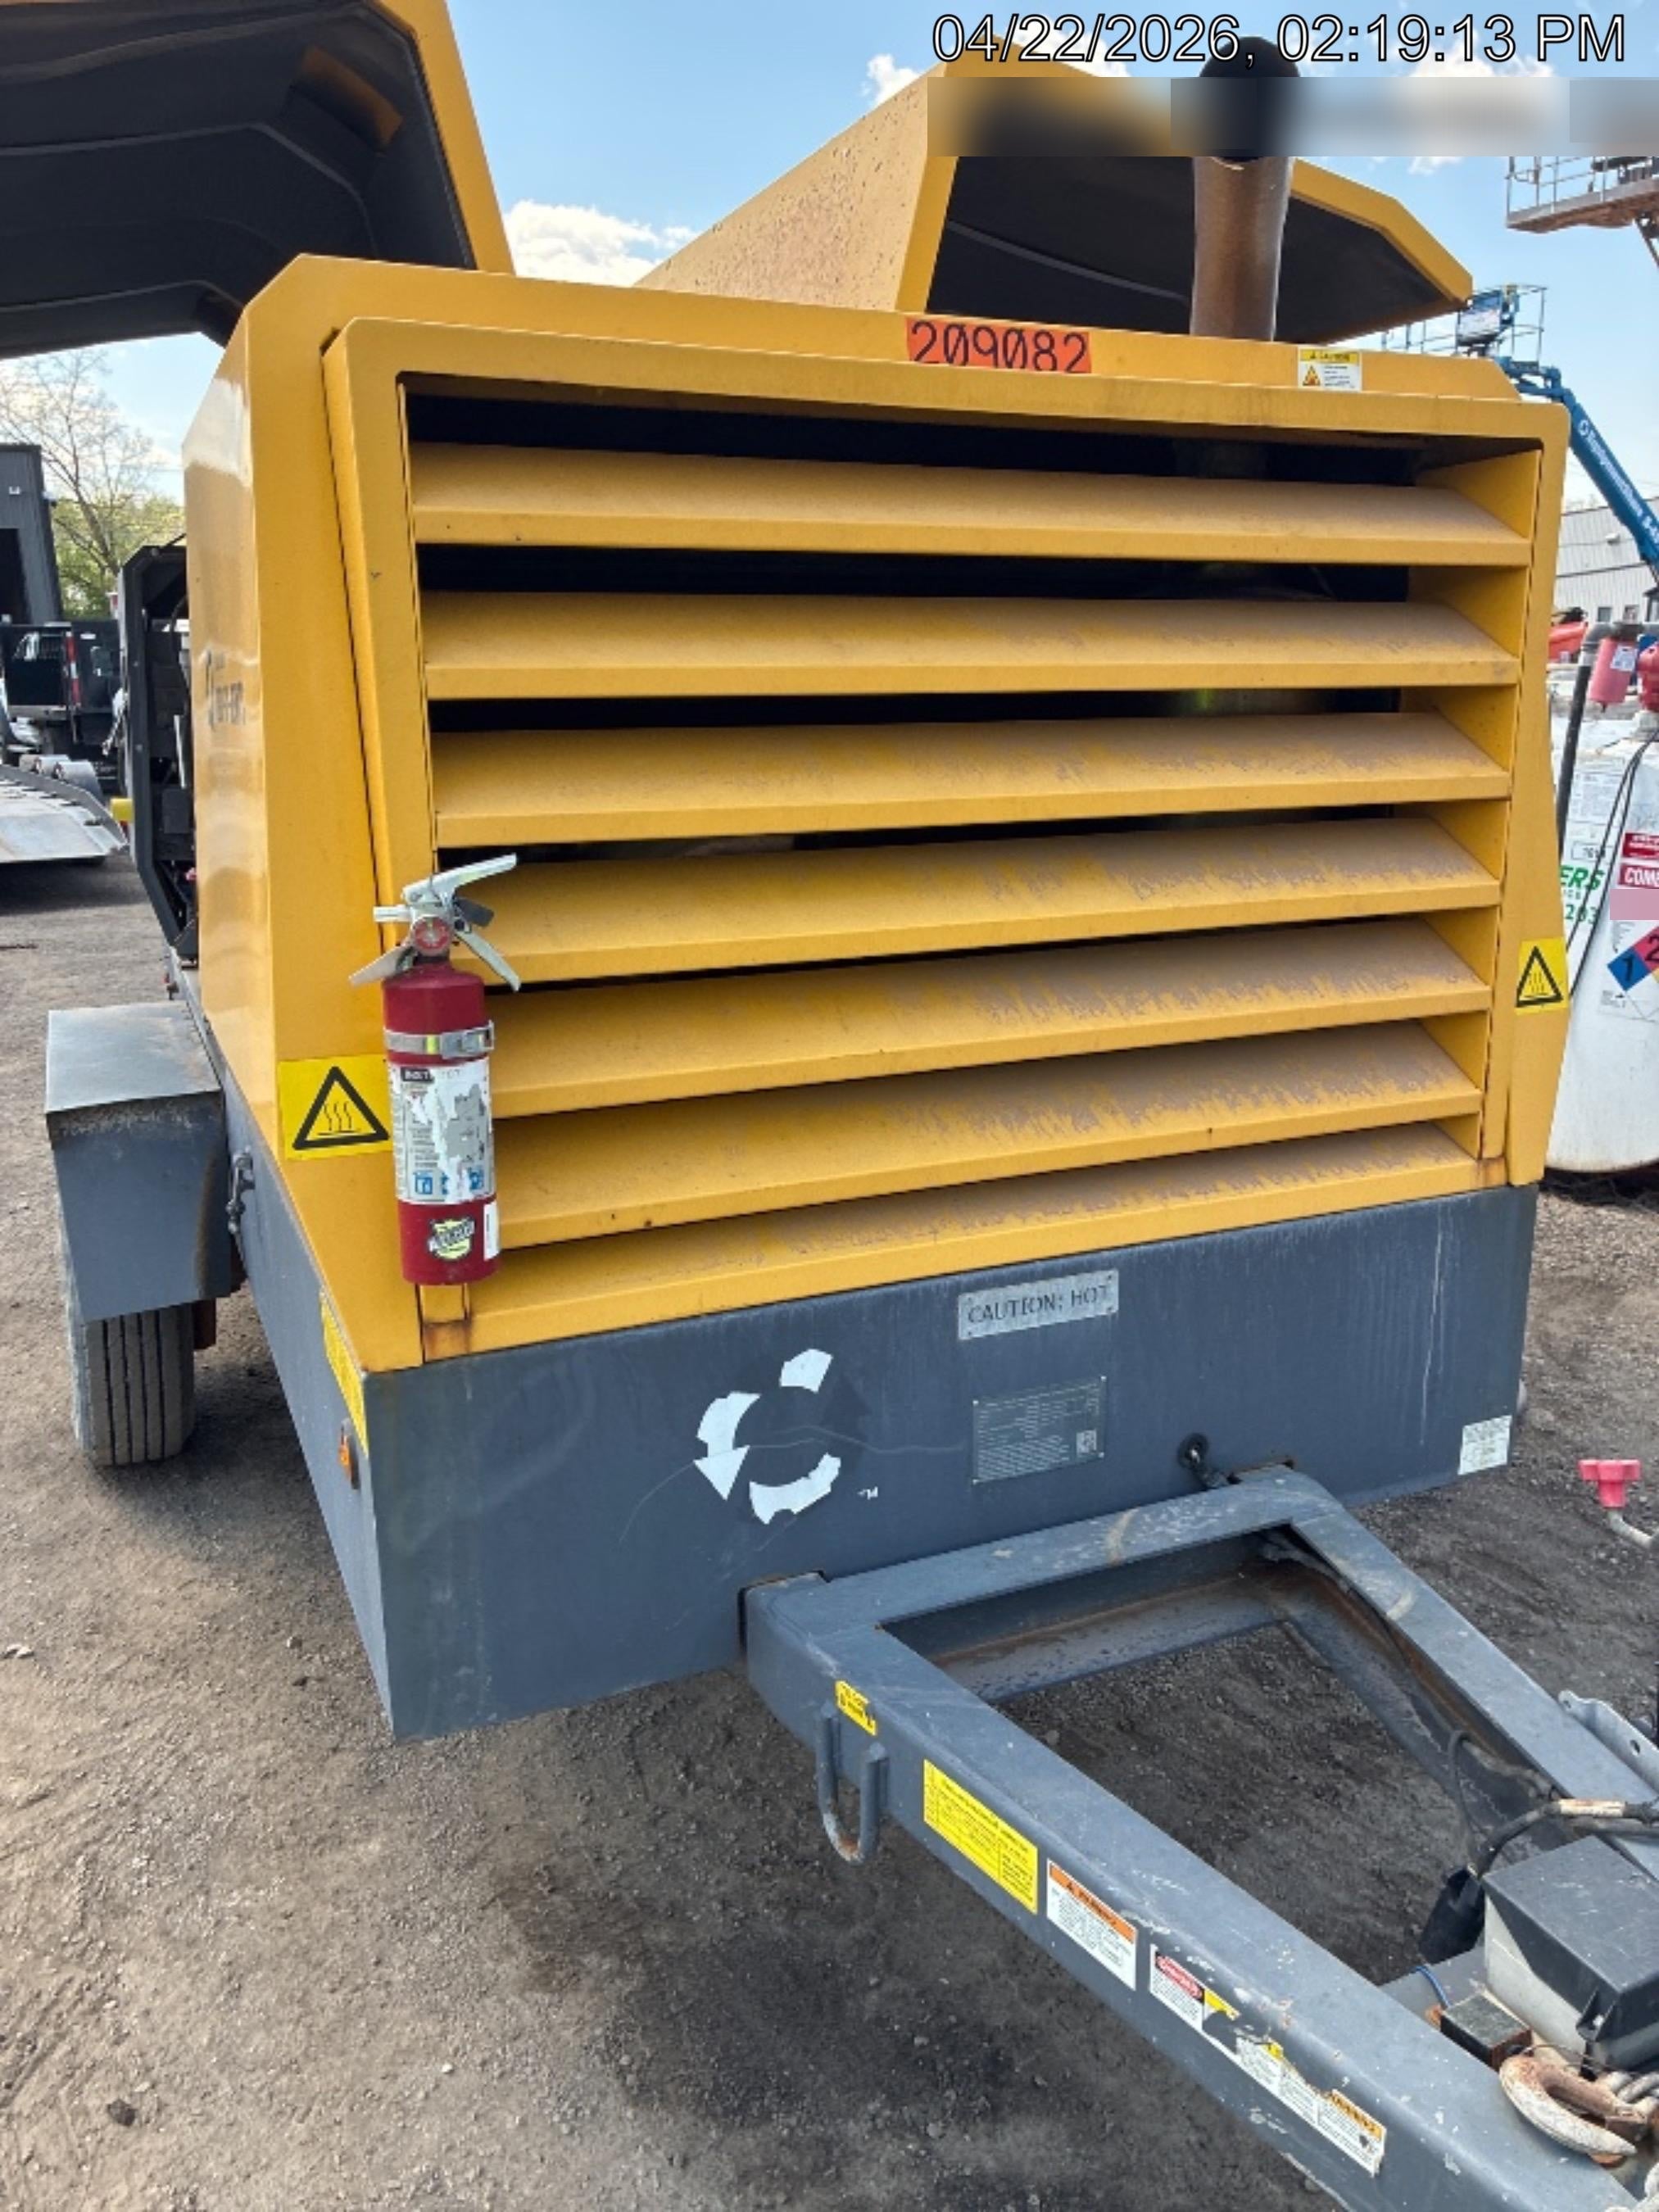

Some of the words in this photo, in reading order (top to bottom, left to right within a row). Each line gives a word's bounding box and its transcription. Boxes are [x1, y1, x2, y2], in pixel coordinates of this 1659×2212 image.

[911, 320, 1092, 373] 209082
[968, 1293, 1063, 1323] CAUTION:
[1071, 1284, 1108, 1308] HOT
